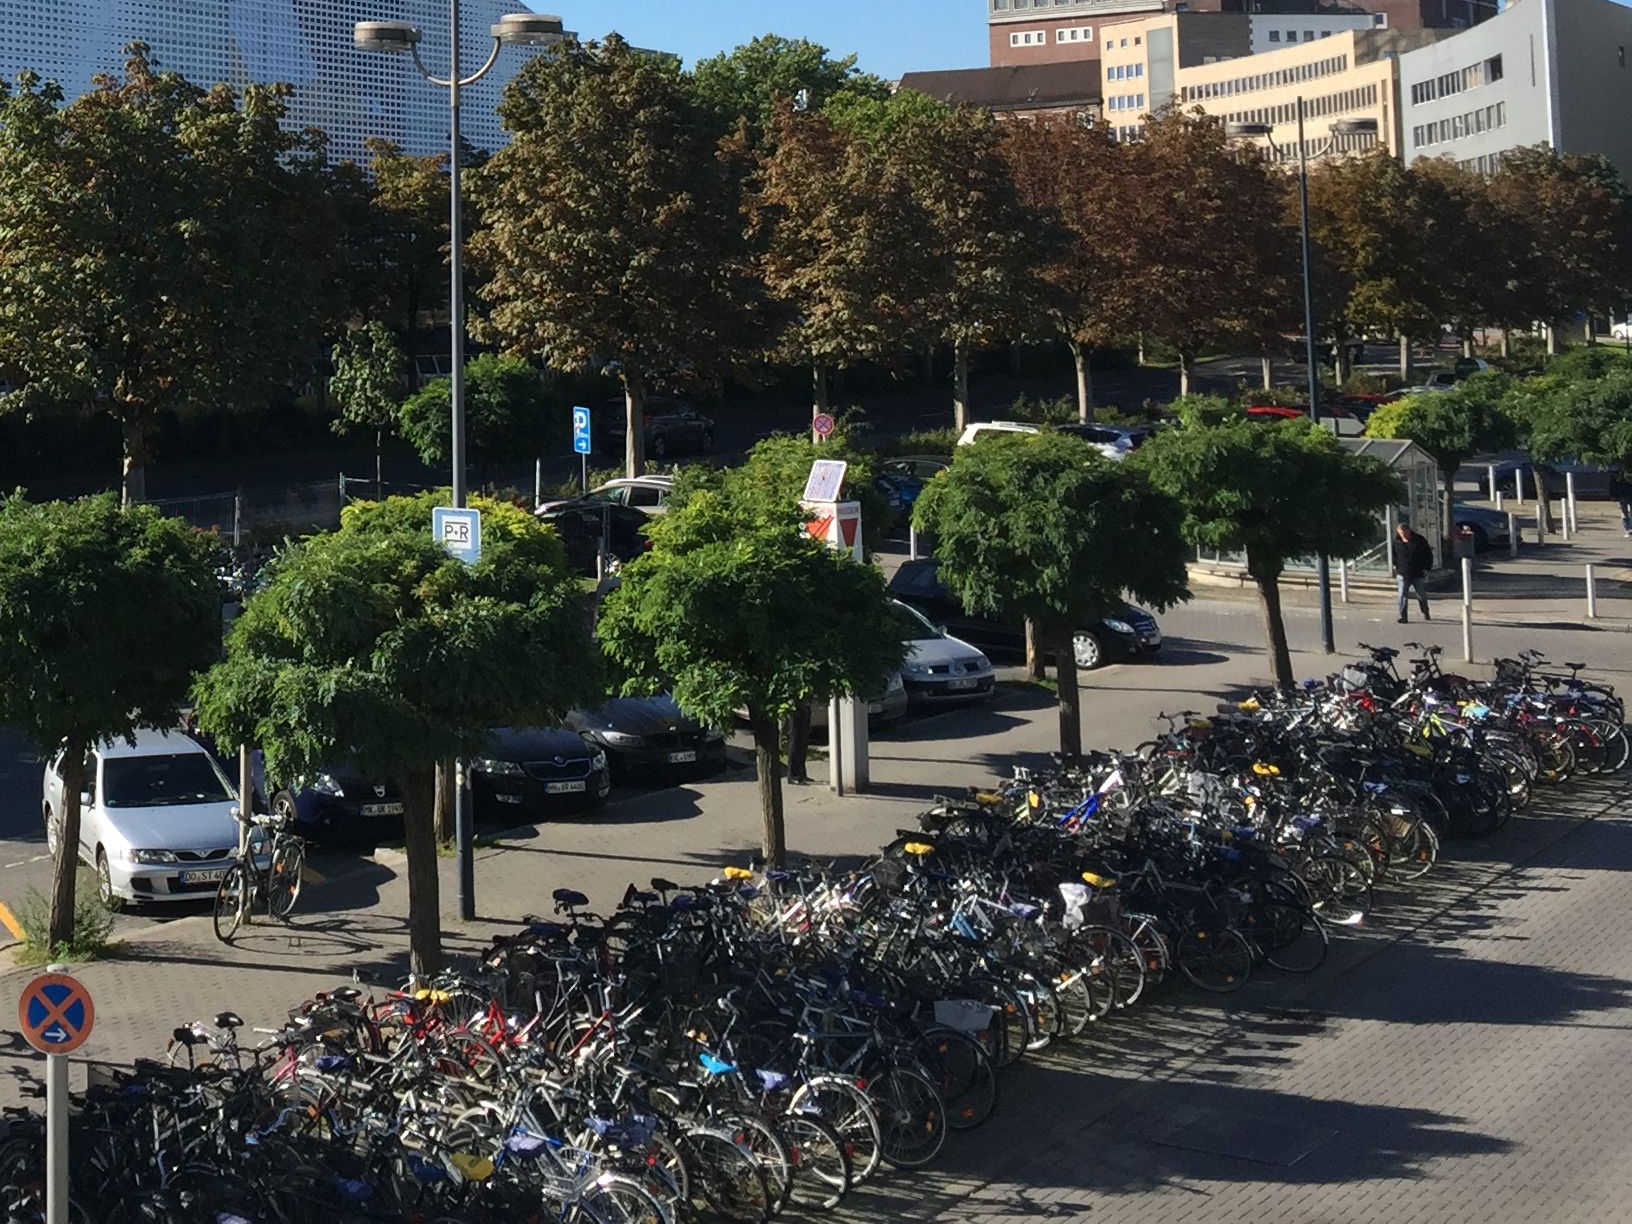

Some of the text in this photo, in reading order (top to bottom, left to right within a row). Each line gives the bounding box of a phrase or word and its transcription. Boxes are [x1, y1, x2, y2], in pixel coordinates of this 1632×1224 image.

[574, 411, 586, 434] P
[186, 872, 196, 881] DO
[201, 871, 213, 881] ST
